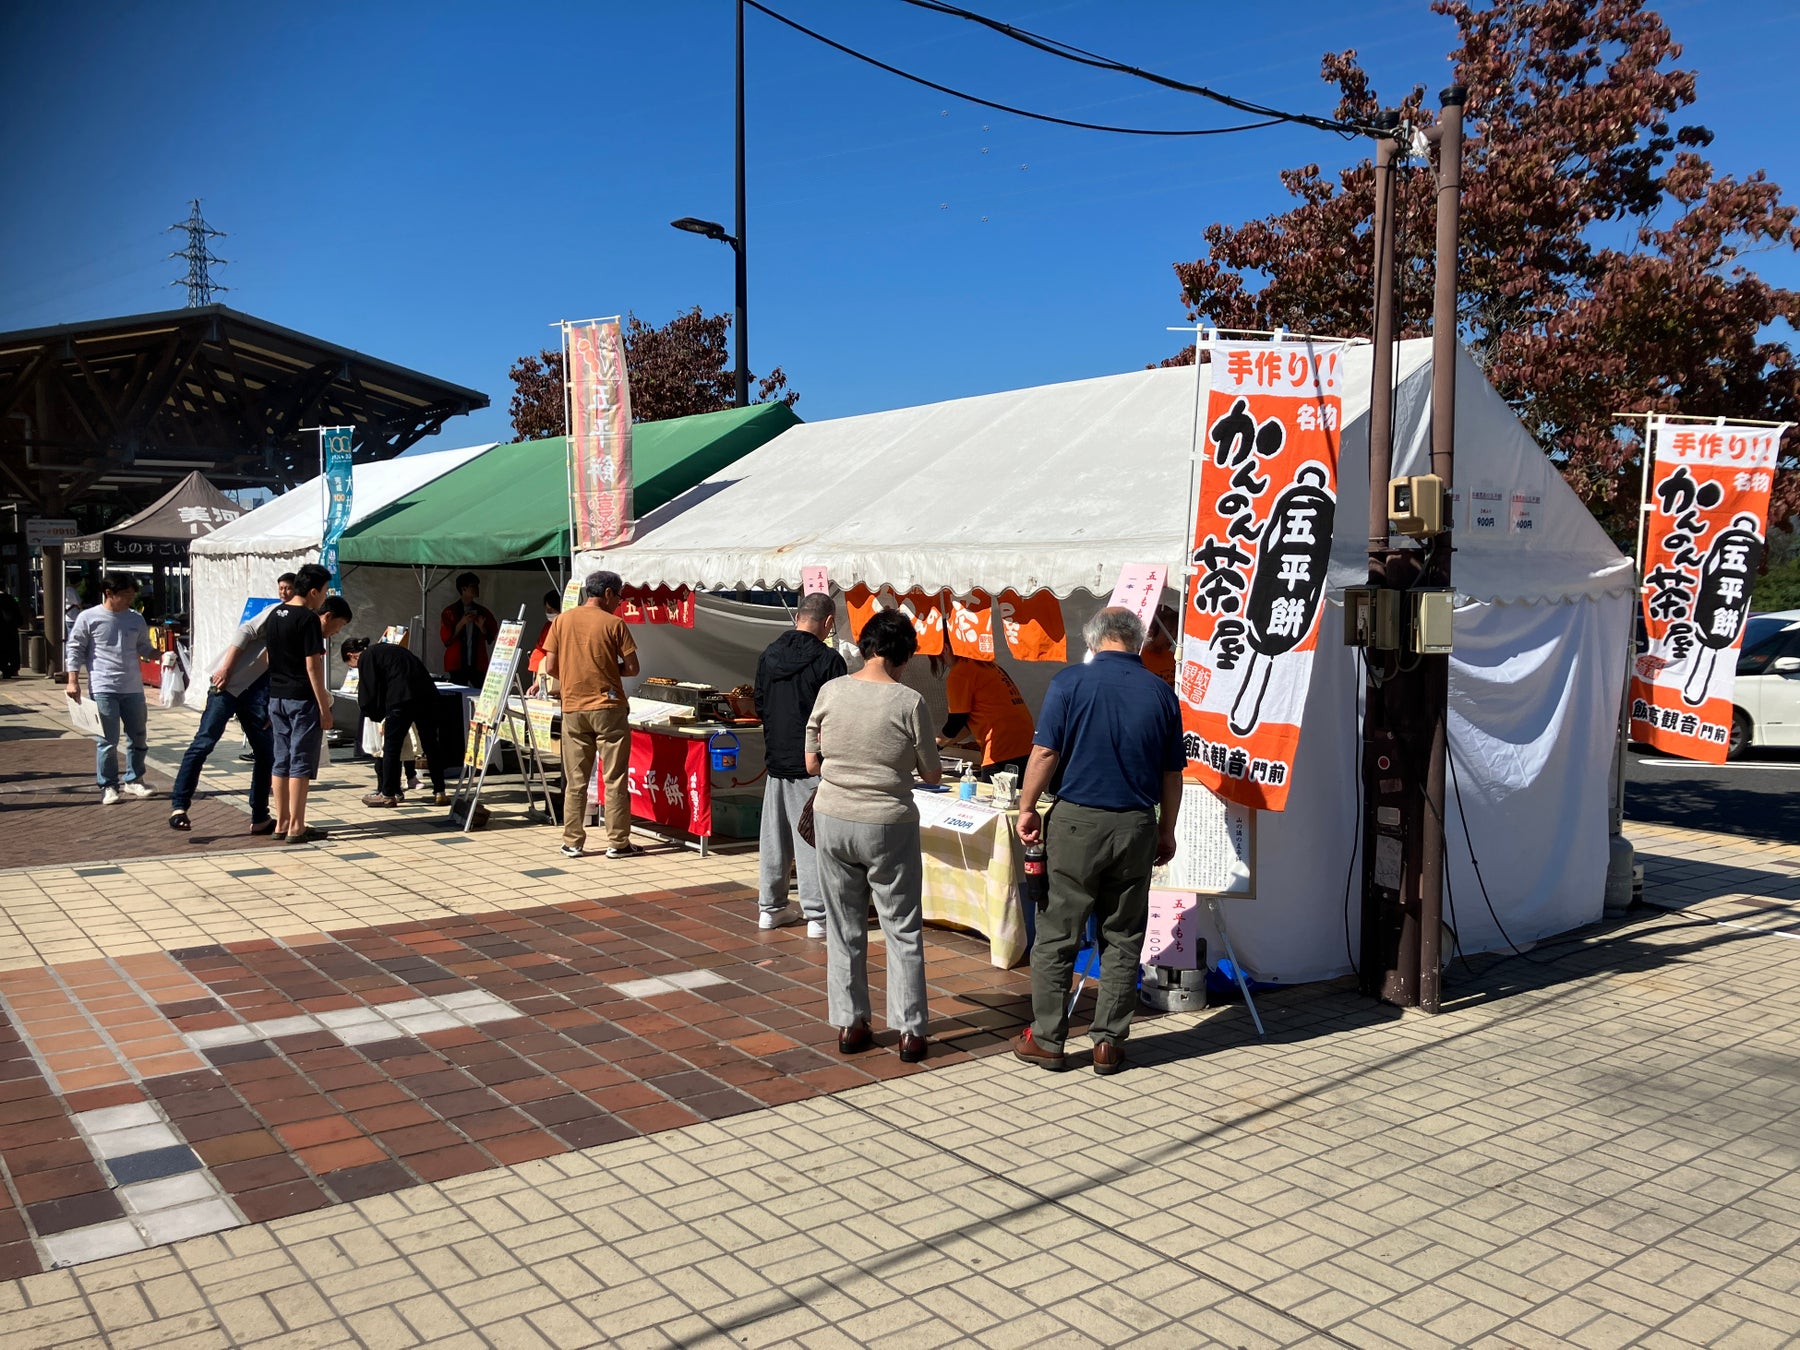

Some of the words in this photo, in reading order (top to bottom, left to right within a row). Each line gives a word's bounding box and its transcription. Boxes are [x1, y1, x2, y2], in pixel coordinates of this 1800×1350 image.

[1227, 350, 1337, 388] 手作り!!
[1296, 404, 1337, 431] 名物
[1672, 432, 1772, 461] 手作り!!
[1733, 472, 1769, 493] 名物
[114, 541, 189, 555] ものすごい
[1194, 399, 1284, 670] かんのん茶屋
[1266, 508, 1318, 638] 五平餅
[1645, 468, 1722, 659] かんのん茶屋
[1135, 571, 1157, 619] 五平もち
[1711, 545, 1752, 638] 五平餅
[1632, 700, 1699, 733] 飯高観音
[1699, 724, 1727, 743] 門前
[1250, 761, 1286, 784] 門前
[943, 816, 974, 830] 1200円
[1150, 905, 1161, 919] 一本
[1172, 899, 1186, 952] 五平もち
